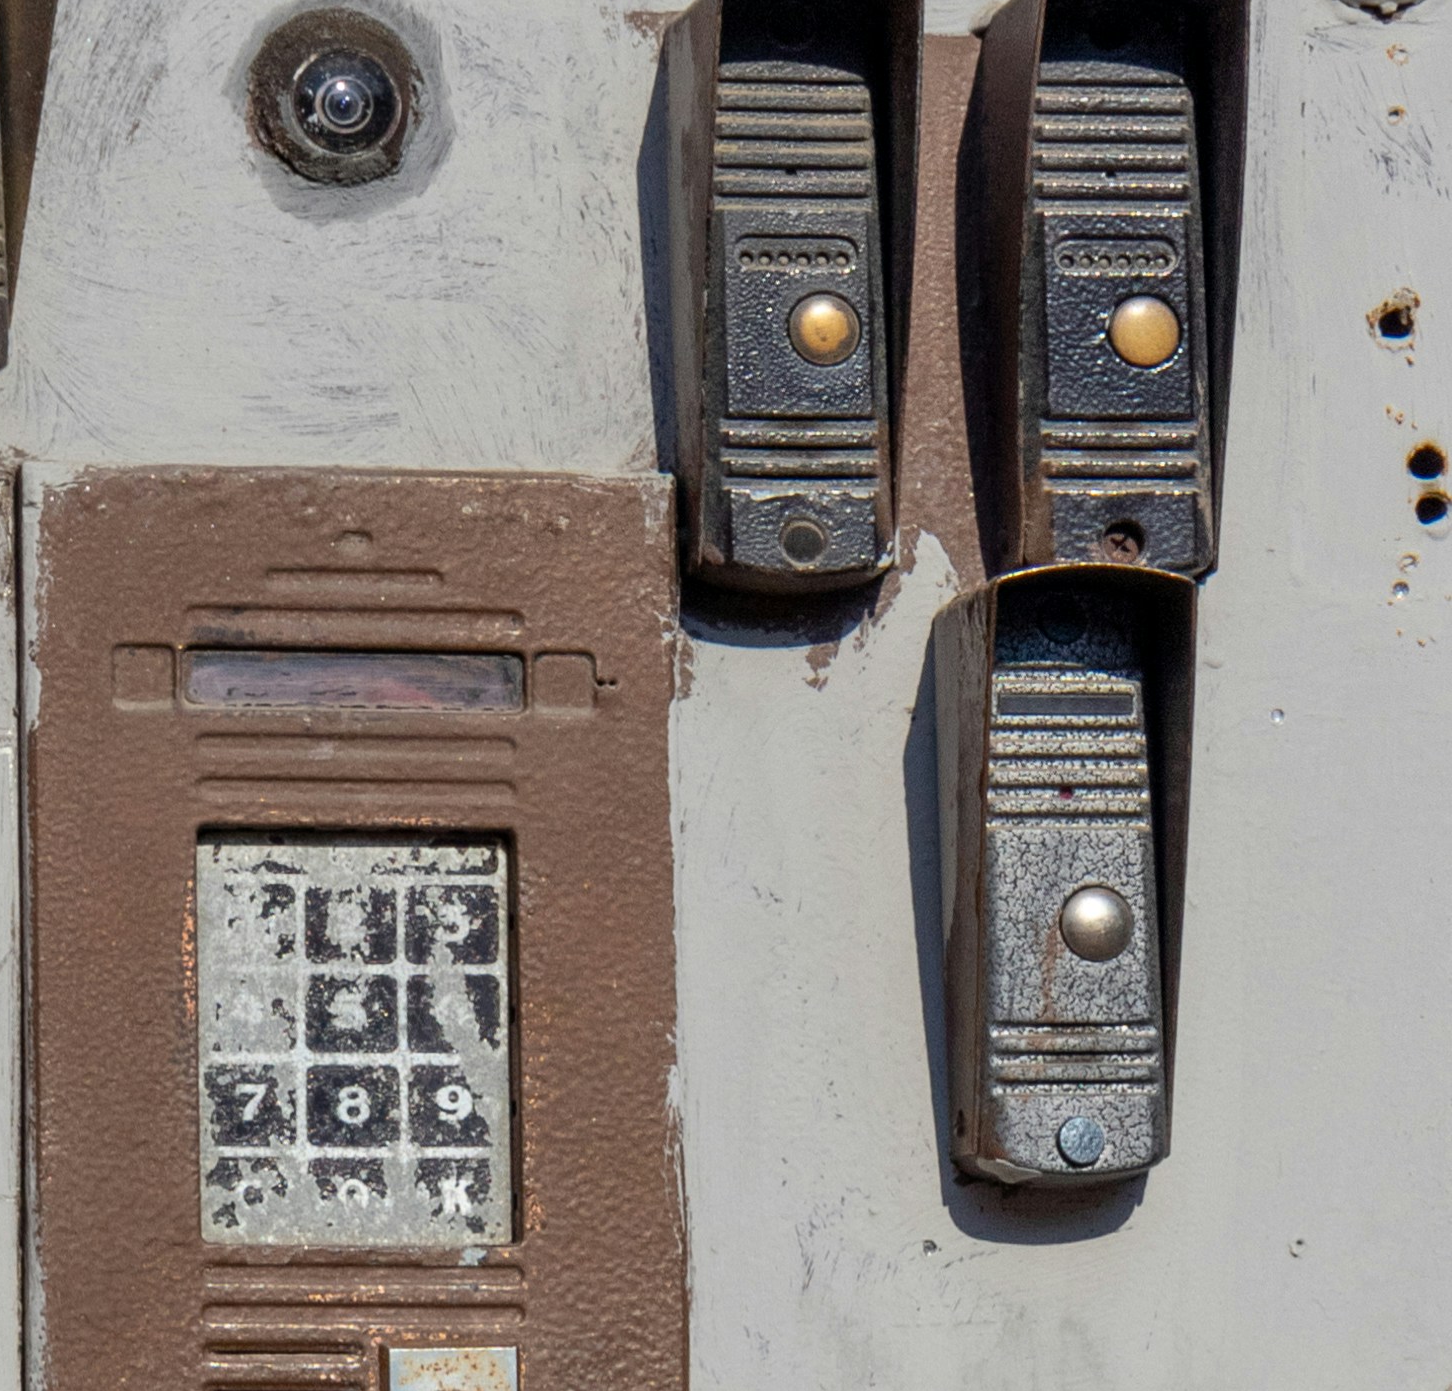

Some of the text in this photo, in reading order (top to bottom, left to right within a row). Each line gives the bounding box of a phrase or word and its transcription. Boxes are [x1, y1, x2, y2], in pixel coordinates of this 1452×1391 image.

[234, 1083, 474, 1125] 7 8 9
